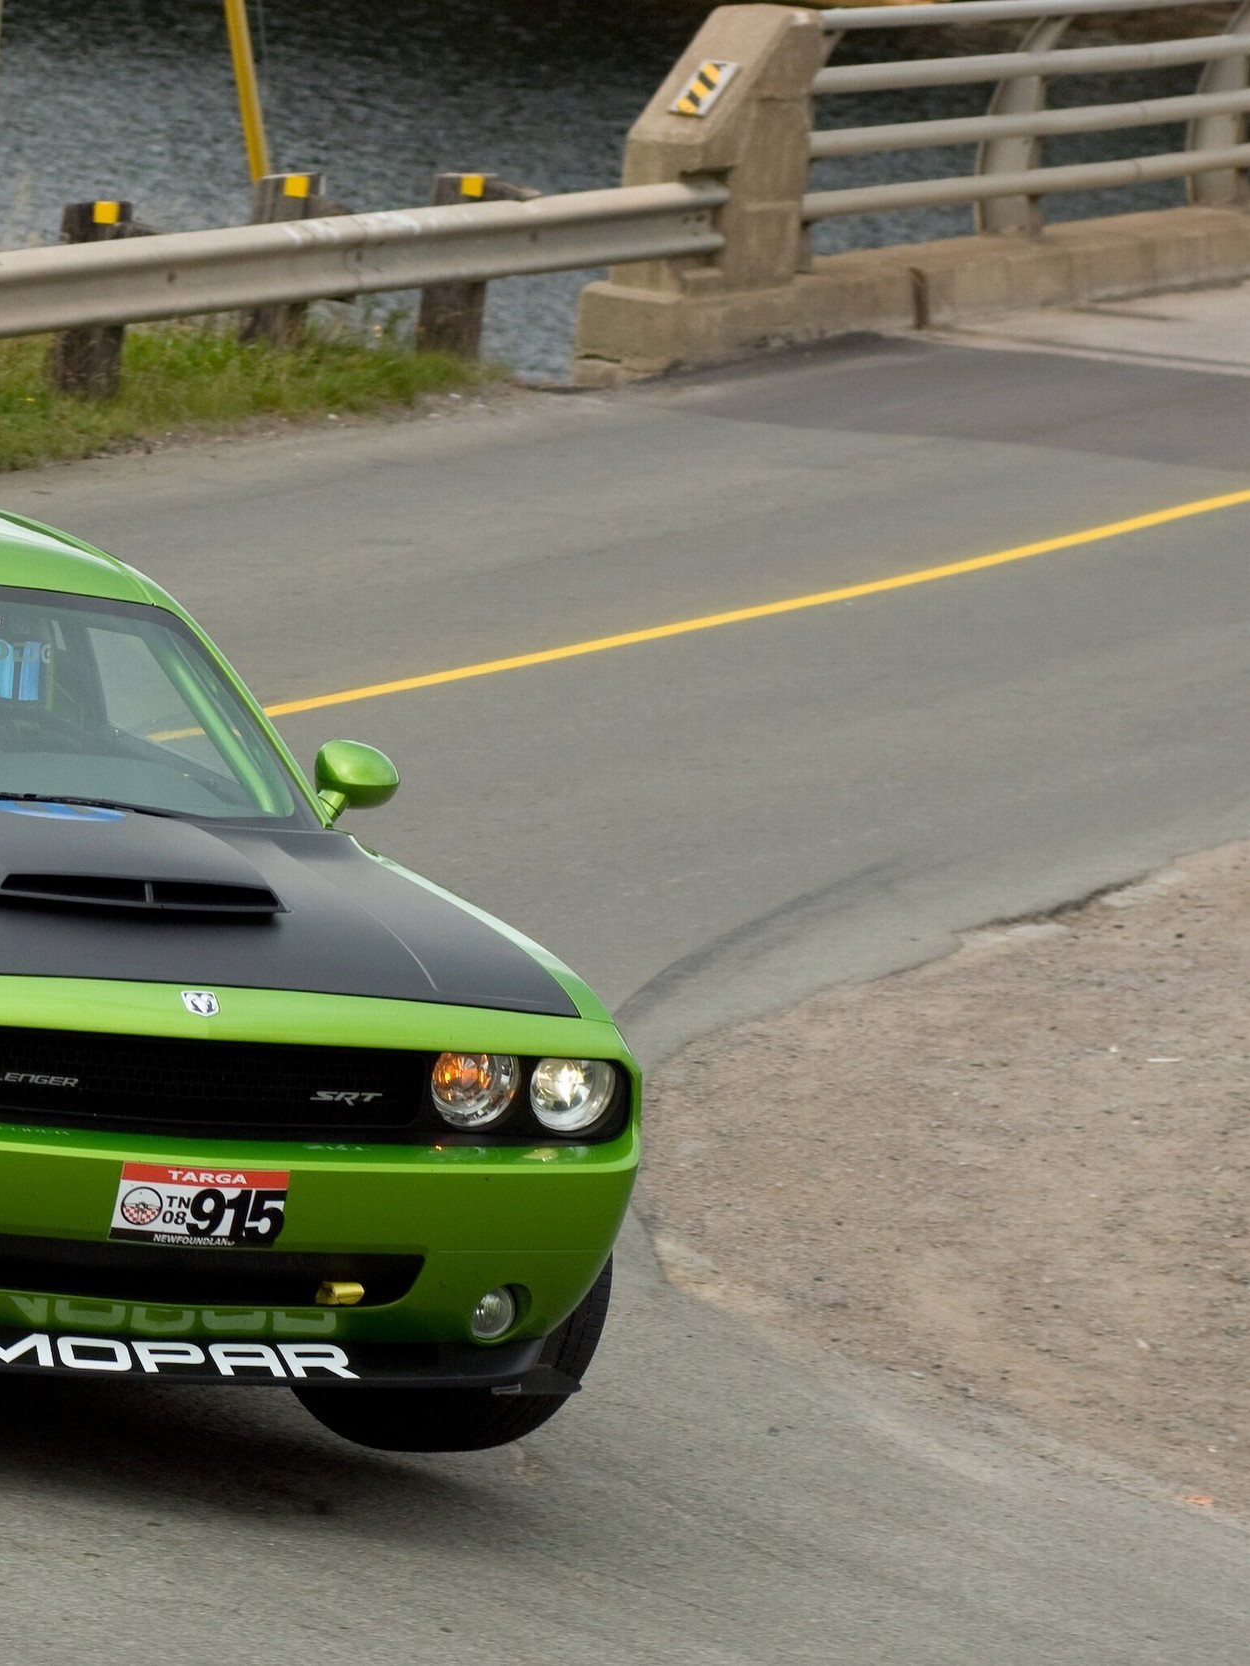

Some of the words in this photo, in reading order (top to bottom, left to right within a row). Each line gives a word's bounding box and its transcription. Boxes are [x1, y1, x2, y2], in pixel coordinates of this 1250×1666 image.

[310, 1090, 383, 1107] SRT
[168, 1169, 248, 1185] TARGA
[161, 1210, 187, 1226] 08
[166, 1195, 192, 1210] TN
[185, 1188, 288, 1242] 915
